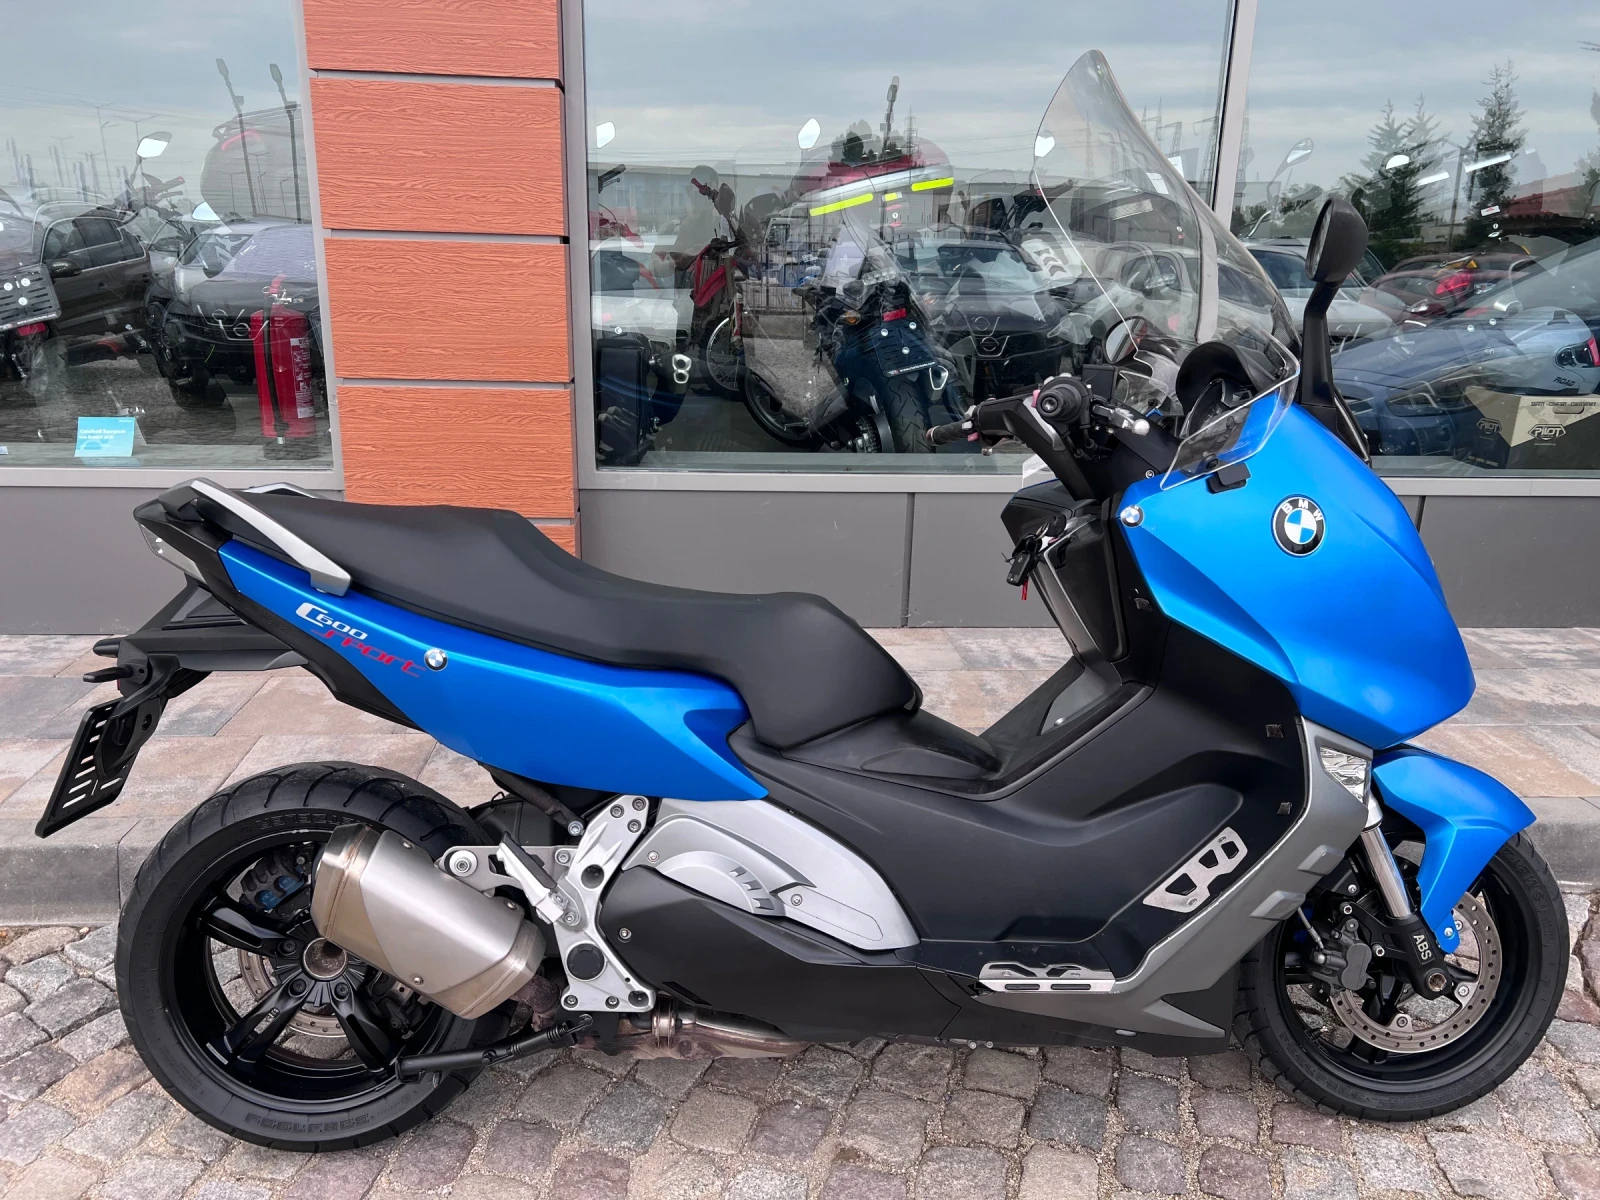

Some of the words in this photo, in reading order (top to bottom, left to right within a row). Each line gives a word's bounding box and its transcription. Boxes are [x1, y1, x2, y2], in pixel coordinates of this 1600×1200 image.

[1281, 498, 1323, 521] BMW
[295, 602, 368, 640] C600
[1413, 934, 1432, 960] ABS
